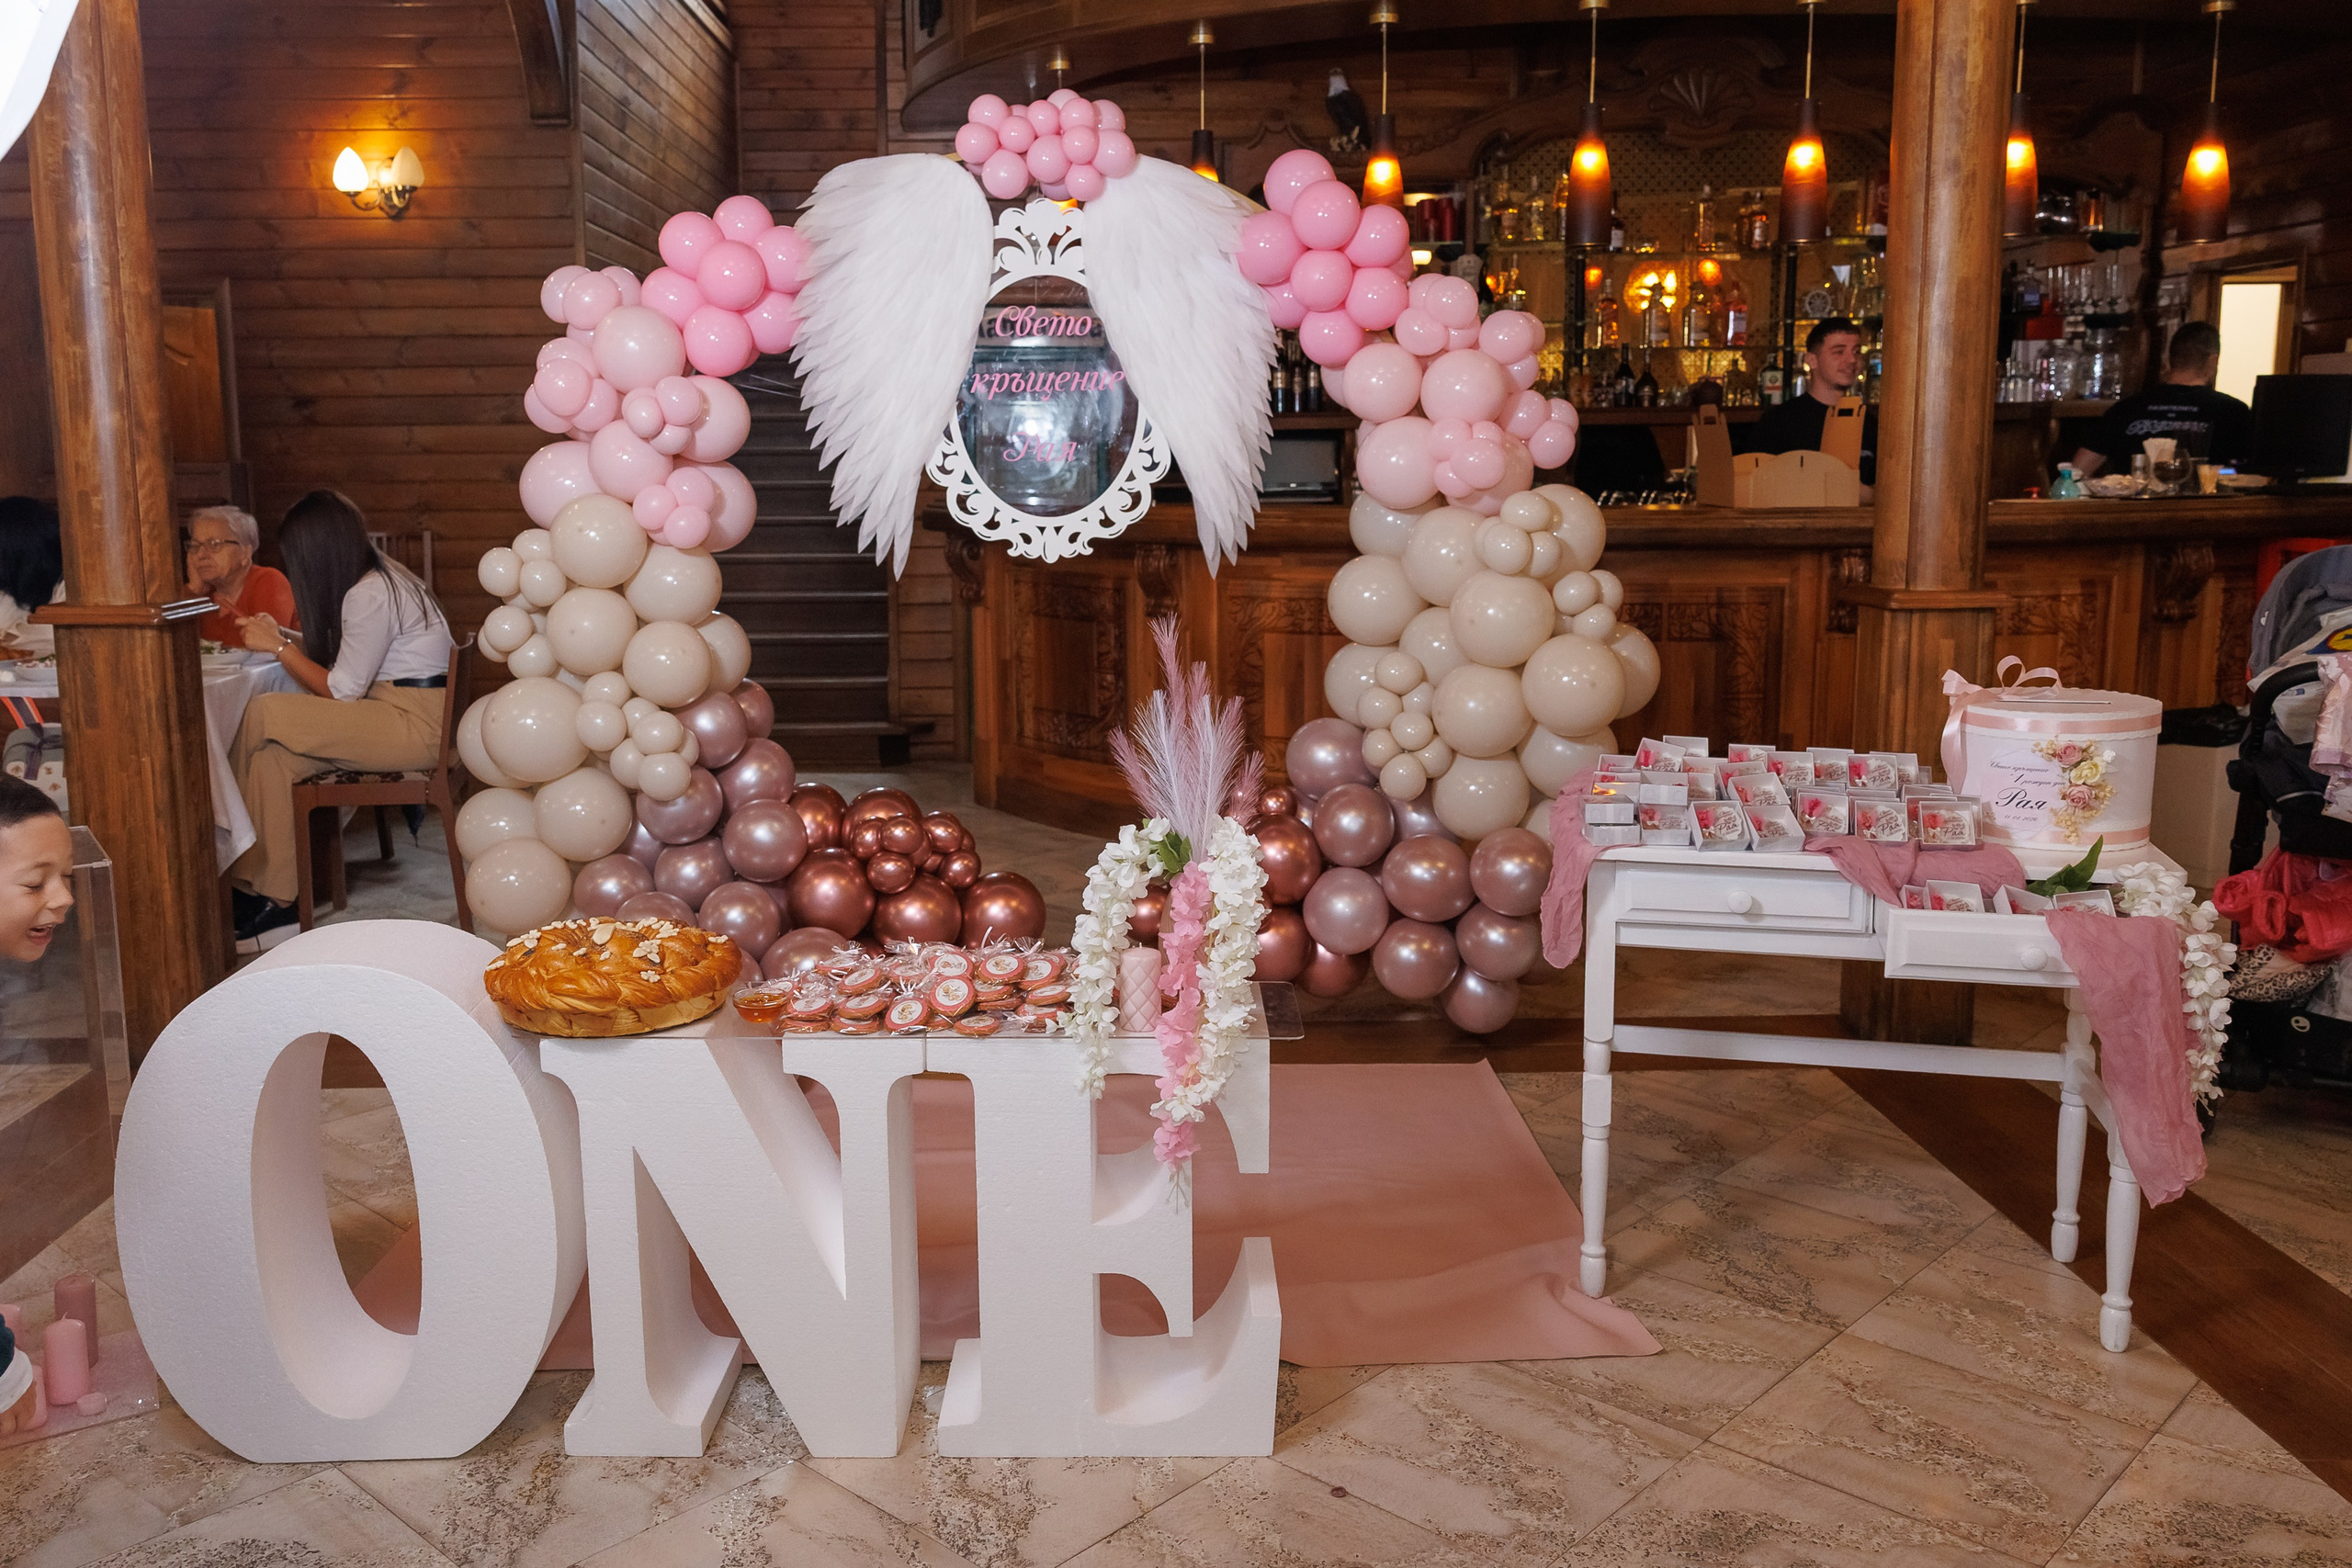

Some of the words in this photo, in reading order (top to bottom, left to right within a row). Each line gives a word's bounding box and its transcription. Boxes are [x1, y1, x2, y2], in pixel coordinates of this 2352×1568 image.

[995, 305, 1092, 337] Свето
[970, 370, 1125, 400] кръщение
[1002, 432, 1078, 462] Рая
[1995, 787, 2048, 810] Рая
[114, 919, 1282, 1464] ONE
